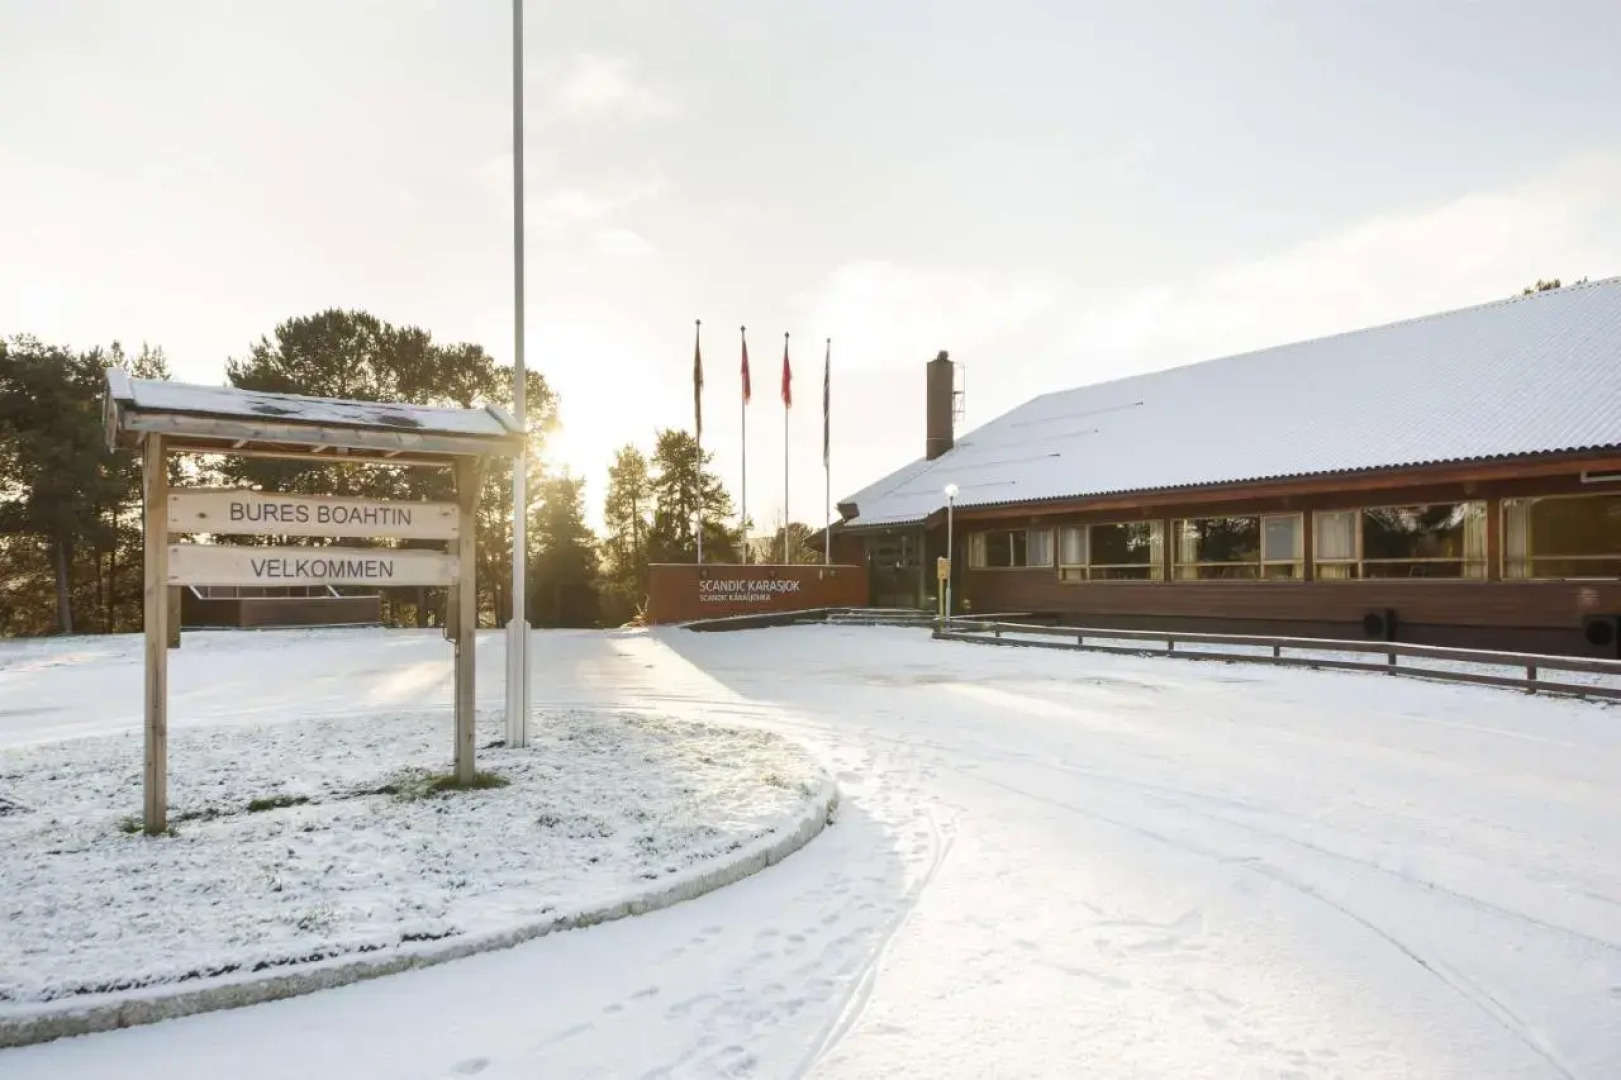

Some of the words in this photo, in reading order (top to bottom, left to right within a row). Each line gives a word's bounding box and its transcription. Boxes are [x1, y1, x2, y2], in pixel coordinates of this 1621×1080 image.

[230, 503, 309, 522] BURES
[317, 506, 411, 525] BOAHTIN
[251, 559, 394, 578] VELKOMMEN
[700, 580, 746, 592] SCANDIC
[748, 580, 800, 593] KARASJOK
